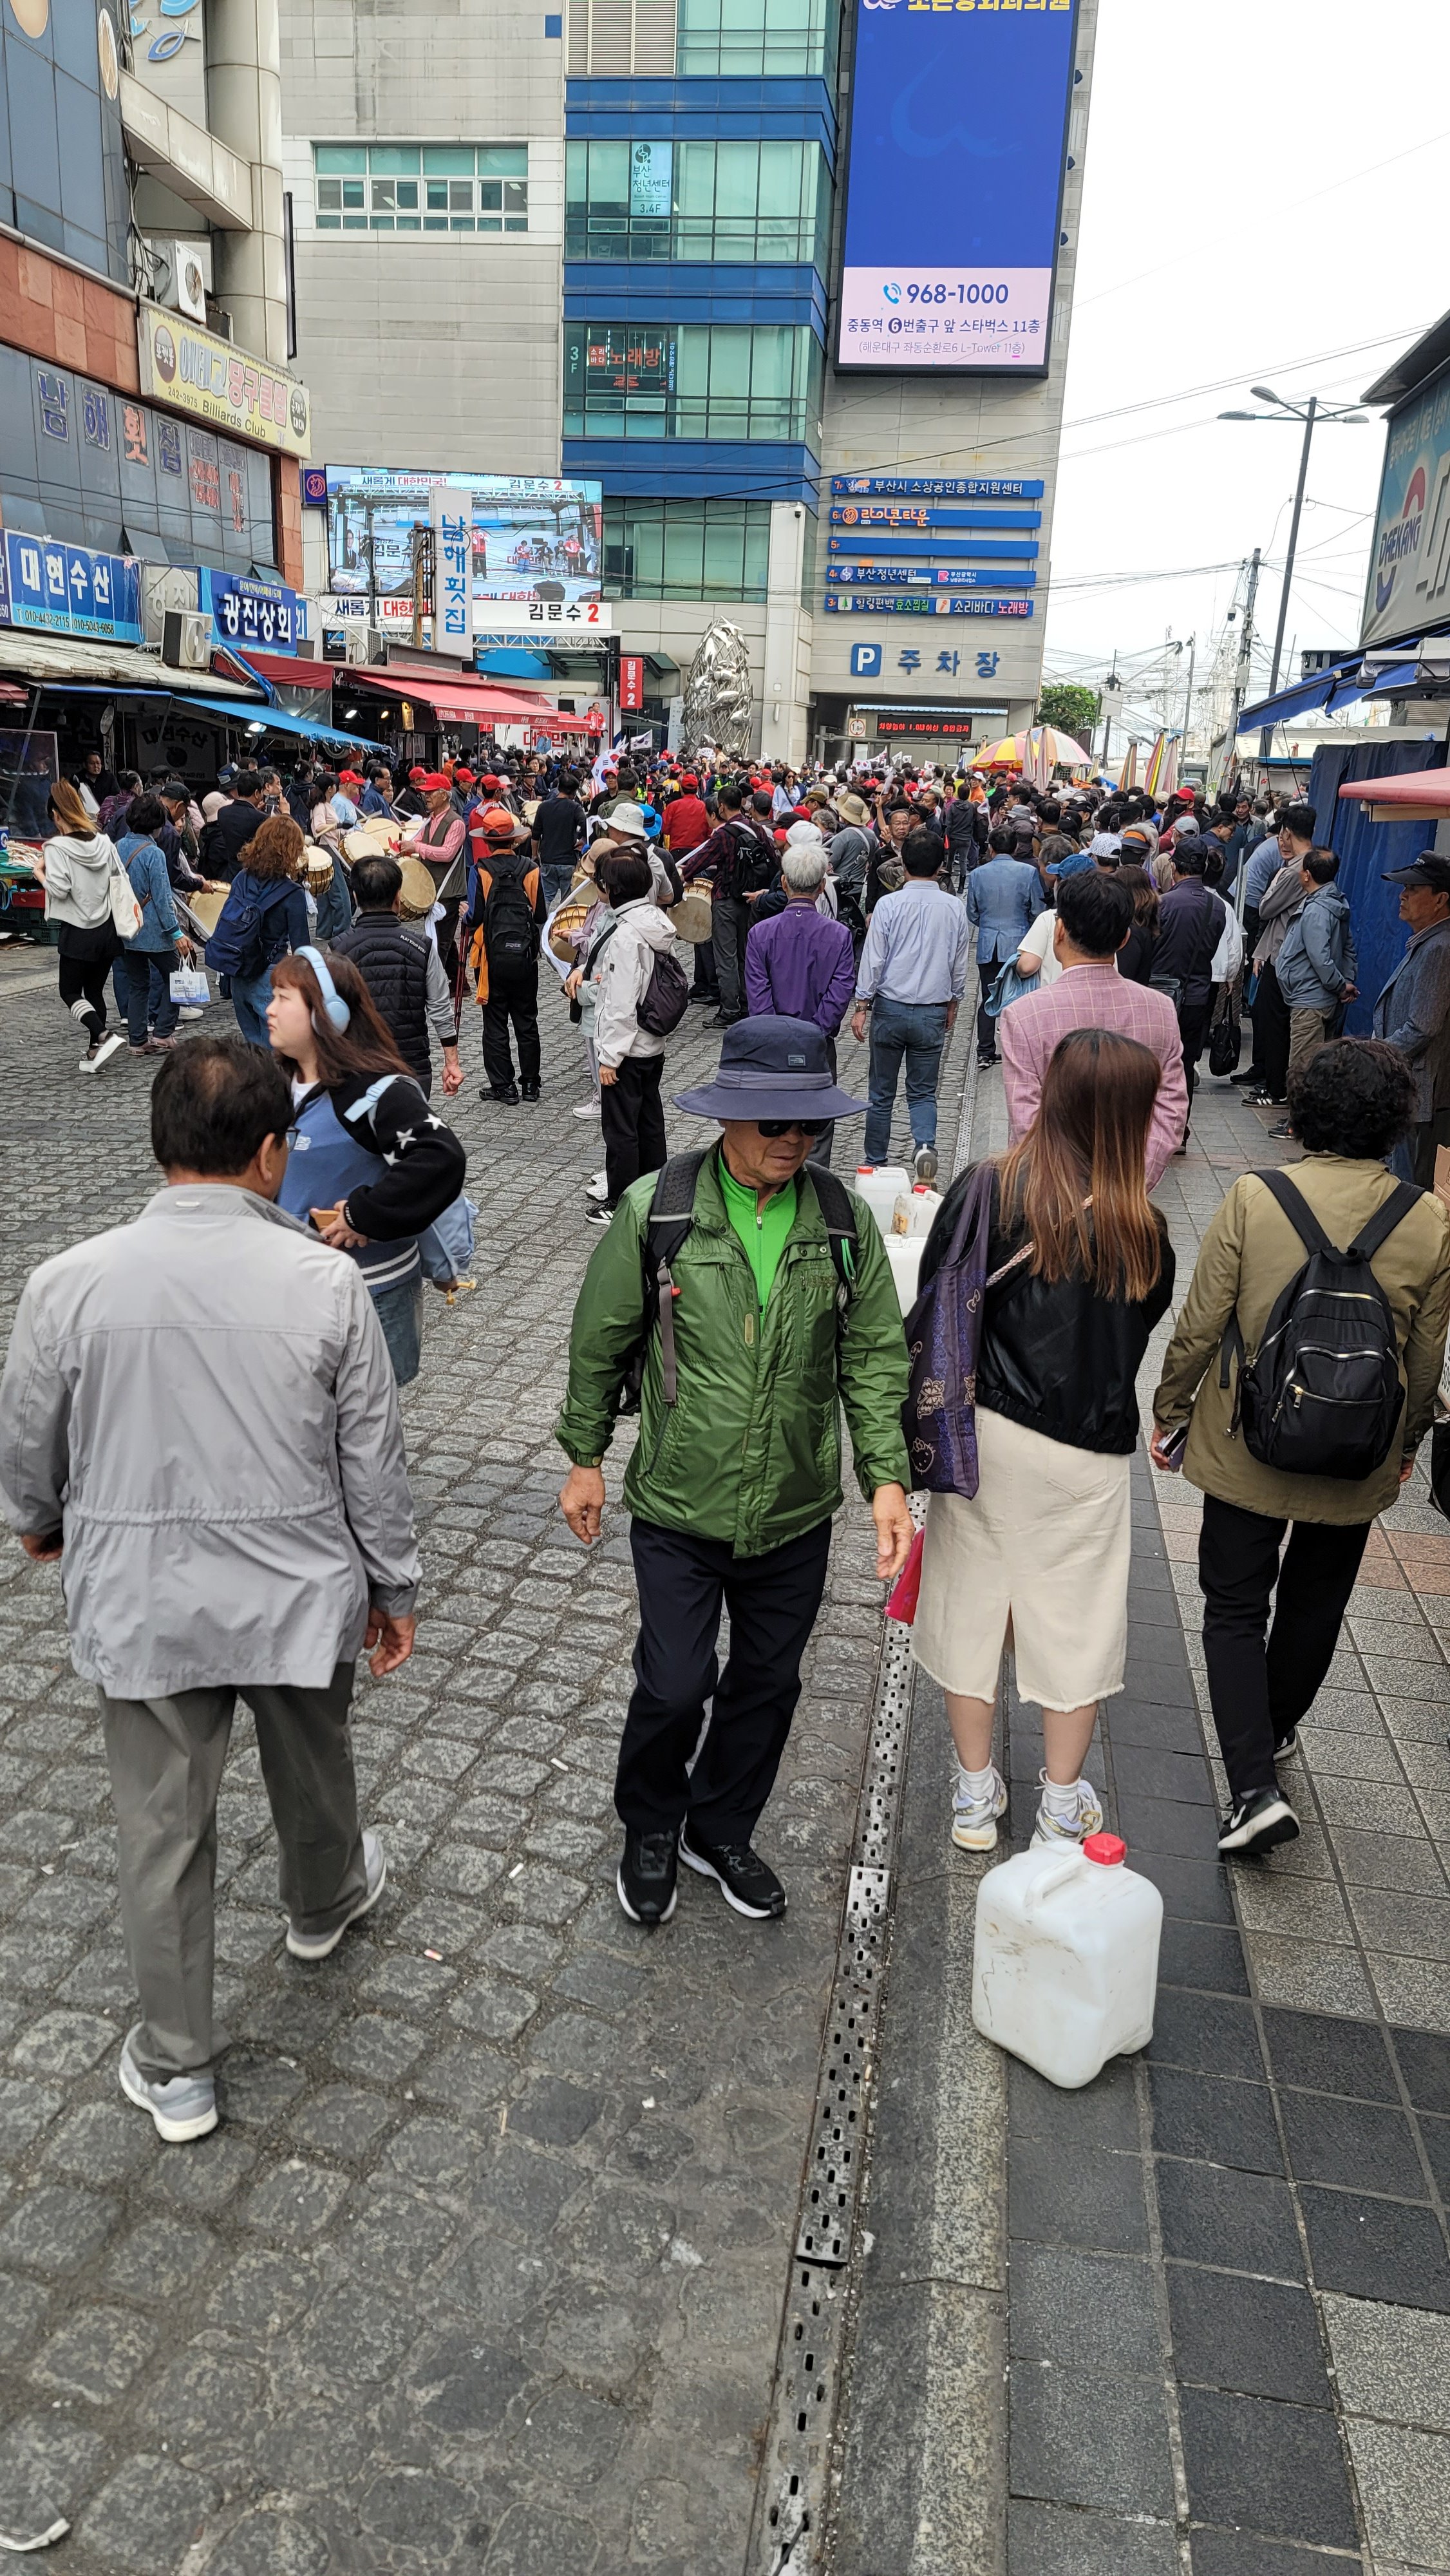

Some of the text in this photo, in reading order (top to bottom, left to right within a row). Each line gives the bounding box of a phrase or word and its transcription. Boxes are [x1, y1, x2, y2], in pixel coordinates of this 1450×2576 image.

[633, 166, 652, 178] 부산
[633, 180, 670, 193] 청년센터
[907, 284, 1008, 304] 968-1000
[847, 318, 883, 333] 중동역
[944, 319, 956, 333] 앞
[959, 319, 1008, 334] 스타벅스
[1013, 319, 1040, 334] 11층
[156, 343, 174, 368] 포켓볼
[570, 346, 579, 361] 3
[610, 347, 660, 367] 노래방
[859, 341, 1025, 354] (해운대구 좌동순환로6 L-Tower 11층)
[571, 363, 578, 374] F
[168, 386, 198, 407] 242-3975
[229, 358, 288, 428] 당구클럽
[292, 398, 305, 419] 국제식
[203, 401, 266, 438] Billiards Club
[509, 479, 549, 489] 김문수
[554, 480, 563, 491] 2
[874, 480, 907, 493] 부산시
[910, 481, 1022, 495] 소상공인종합지원센터
[861, 507, 930, 526] 라이콘타운
[21, 547, 109, 605] 대현수산
[441, 514, 466, 634] 남해횟집
[529, 603, 581, 621] 김문수
[587, 603, 599, 623] 2
[856, 597, 894, 610] 힐링편백
[896, 599, 928, 611] 효소찜질
[954, 600, 994, 614] 소리바다
[998, 601, 1029, 614] 노래방
[223, 593, 292, 643] 광진상회
[857, 648, 1000, 677] P 주차장
[627, 661, 636, 690] 김문수
[626, 693, 635, 706] 2
